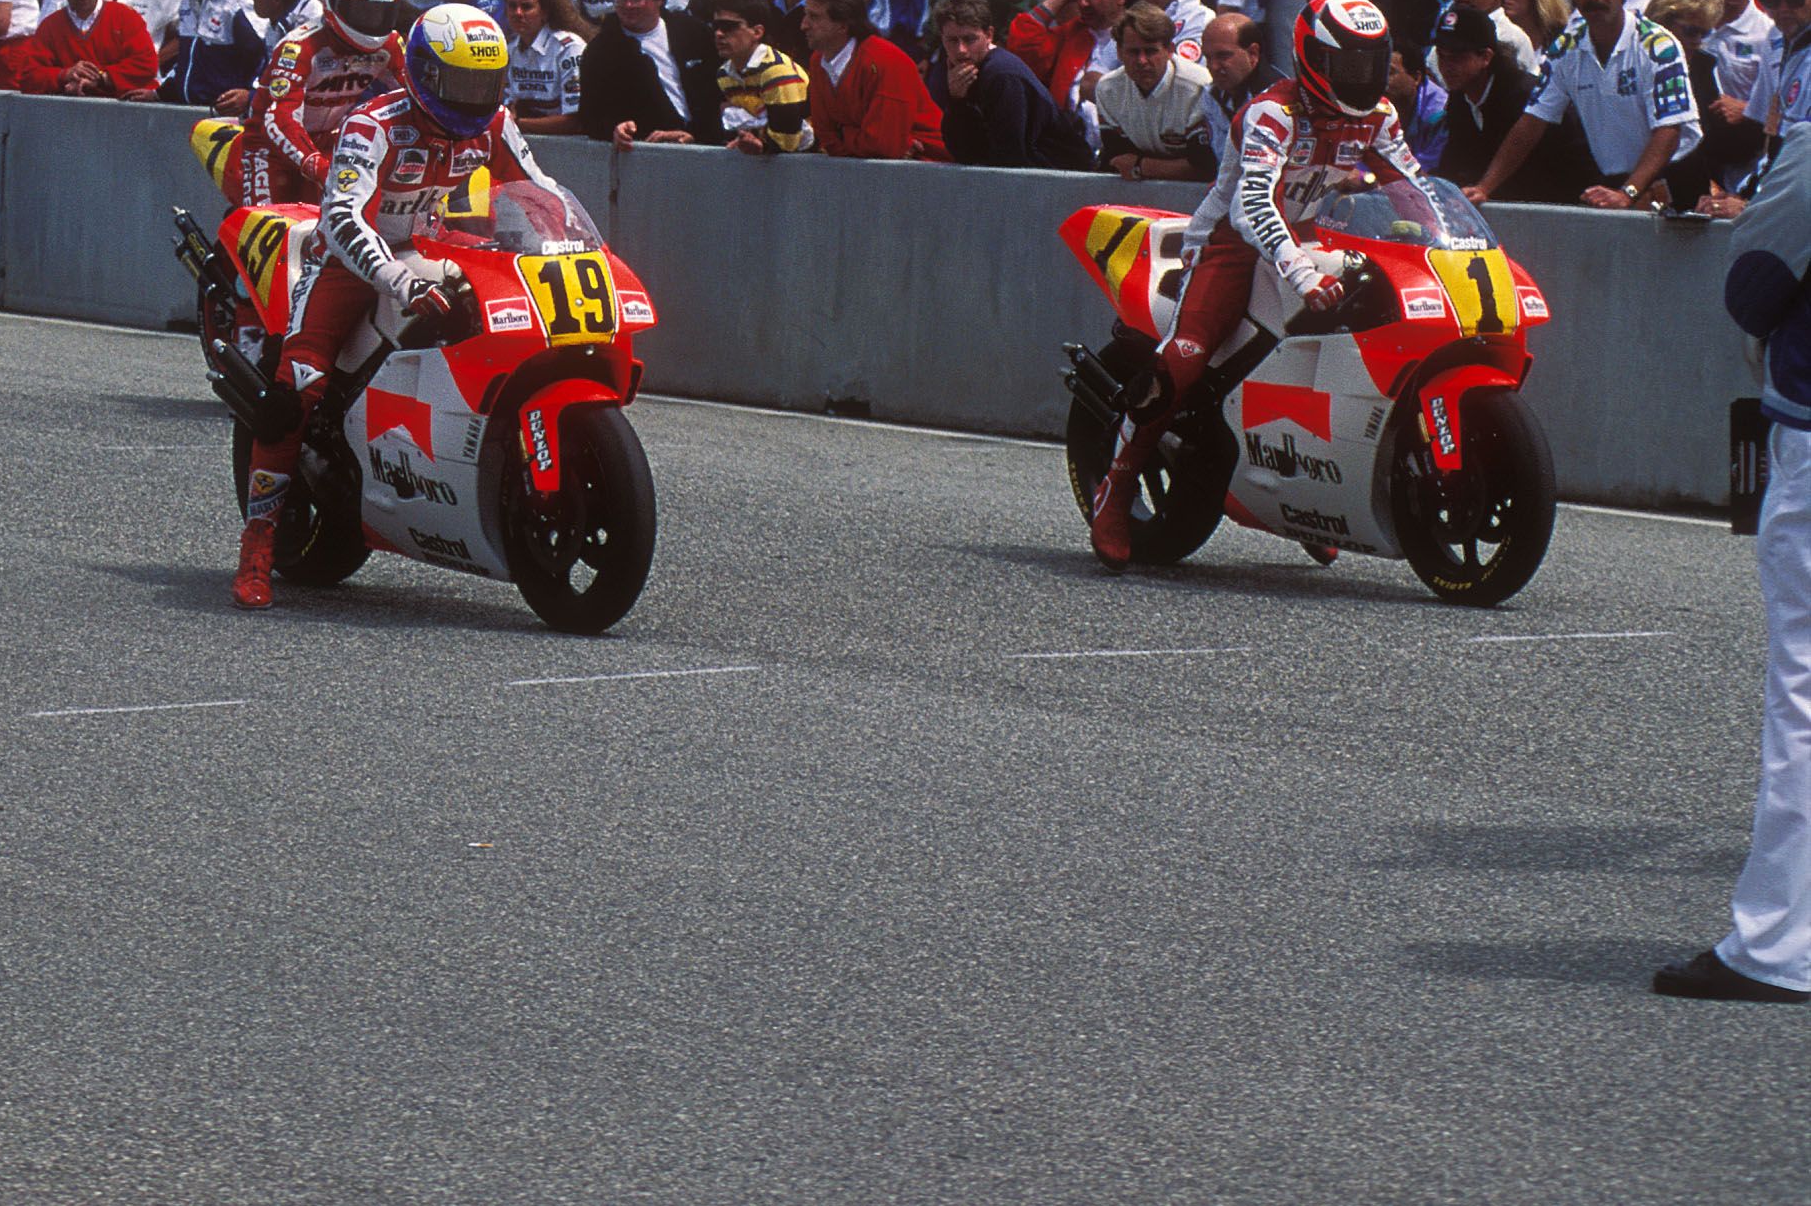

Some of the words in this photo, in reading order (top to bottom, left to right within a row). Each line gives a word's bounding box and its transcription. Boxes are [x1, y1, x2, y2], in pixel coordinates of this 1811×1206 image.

[466, 28, 500, 43] Marlboro
[1353, 19, 1383, 31] SHOEI
[469, 45, 501, 57] SHOEI
[1242, 170, 1290, 255] YAMAHA
[328, 197, 385, 282] YAMAHA
[542, 239, 584, 254] Castrol
[1451, 236, 1487, 250] Castrol
[538, 258, 608, 335] 19
[624, 304, 651, 316] Marlboro
[1408, 301, 1442, 313] Marlboro
[1466, 256, 1504, 334] 1
[491, 309, 529, 324] Marlboro
[462, 417, 483, 460] YAMAHA
[1364, 405, 1386, 441] YAMAHA
[1431, 397, 1456, 455] DUNLOP
[529, 410, 552, 472] DUNLOP
[1245, 432, 1343, 485] Marlboro
[369, 444, 457, 506] Marlboro
[1279, 502, 1351, 536] Castrol
[408, 526, 472, 561] Castrol
